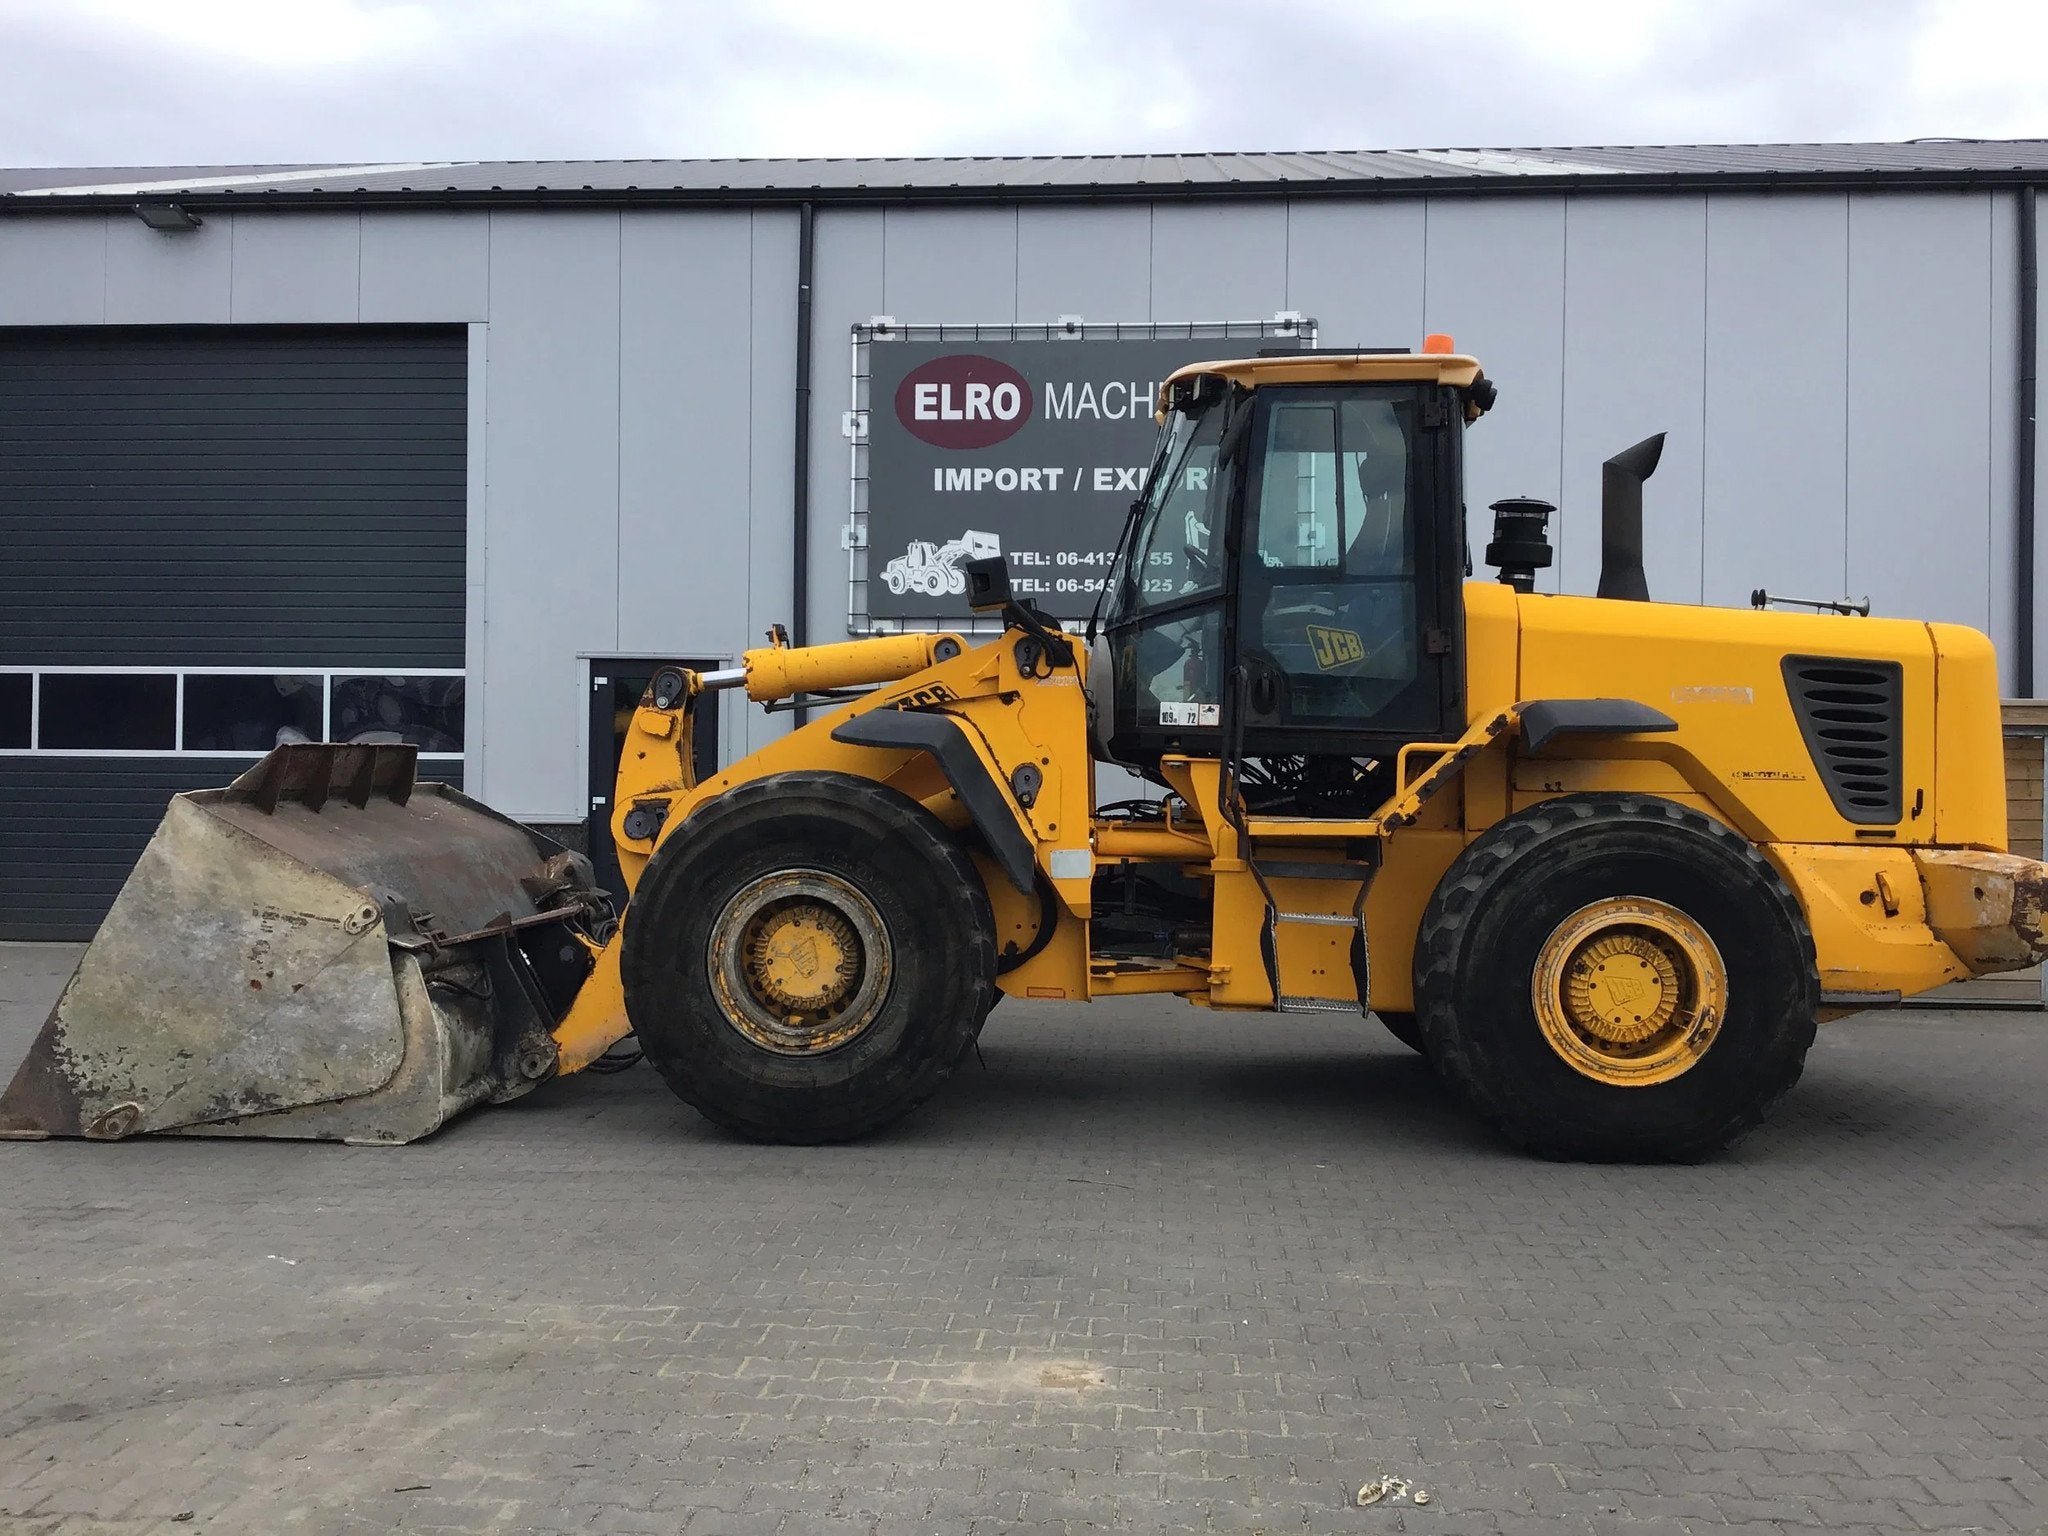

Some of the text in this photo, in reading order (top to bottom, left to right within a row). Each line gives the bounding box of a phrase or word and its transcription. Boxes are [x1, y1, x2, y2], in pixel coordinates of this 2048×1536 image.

[914, 382, 1021, 420] ELRO
[934, 467, 1217, 491] IMPORT / EXR
[1010, 552, 1050, 566] TEL:
[1010, 578, 1050, 592] TEL:
[1317, 629, 1362, 666] JCB
